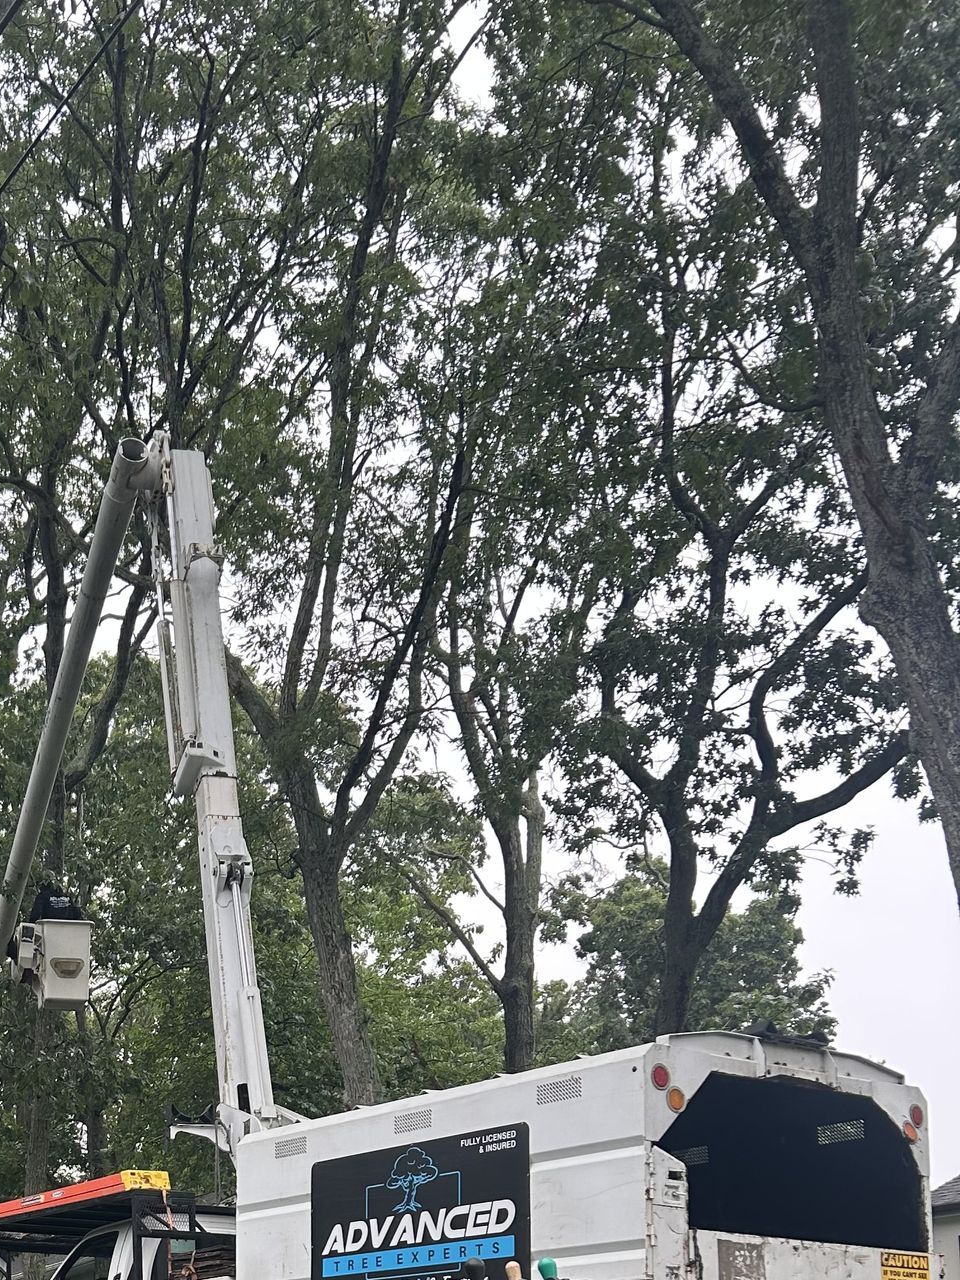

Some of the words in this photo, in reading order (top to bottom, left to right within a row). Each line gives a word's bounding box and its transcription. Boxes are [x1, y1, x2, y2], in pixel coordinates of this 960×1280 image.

[460, 1136, 481, 1148] FULLY
[482, 1130, 517, 1144] LICENSED
[478, 1145, 485, 1154] &
[485, 1139, 517, 1153] INSURED
[321, 1199, 517, 1256] ADVANCED
[333, 1255, 382, 1273] TREE
[396, 1241, 501, 1265] EXPERTS
[882, 1252, 928, 1269] CAUTION
[902, 1271, 917, 1279] CAN'T
[918, 1272, 927, 1280] SEE
